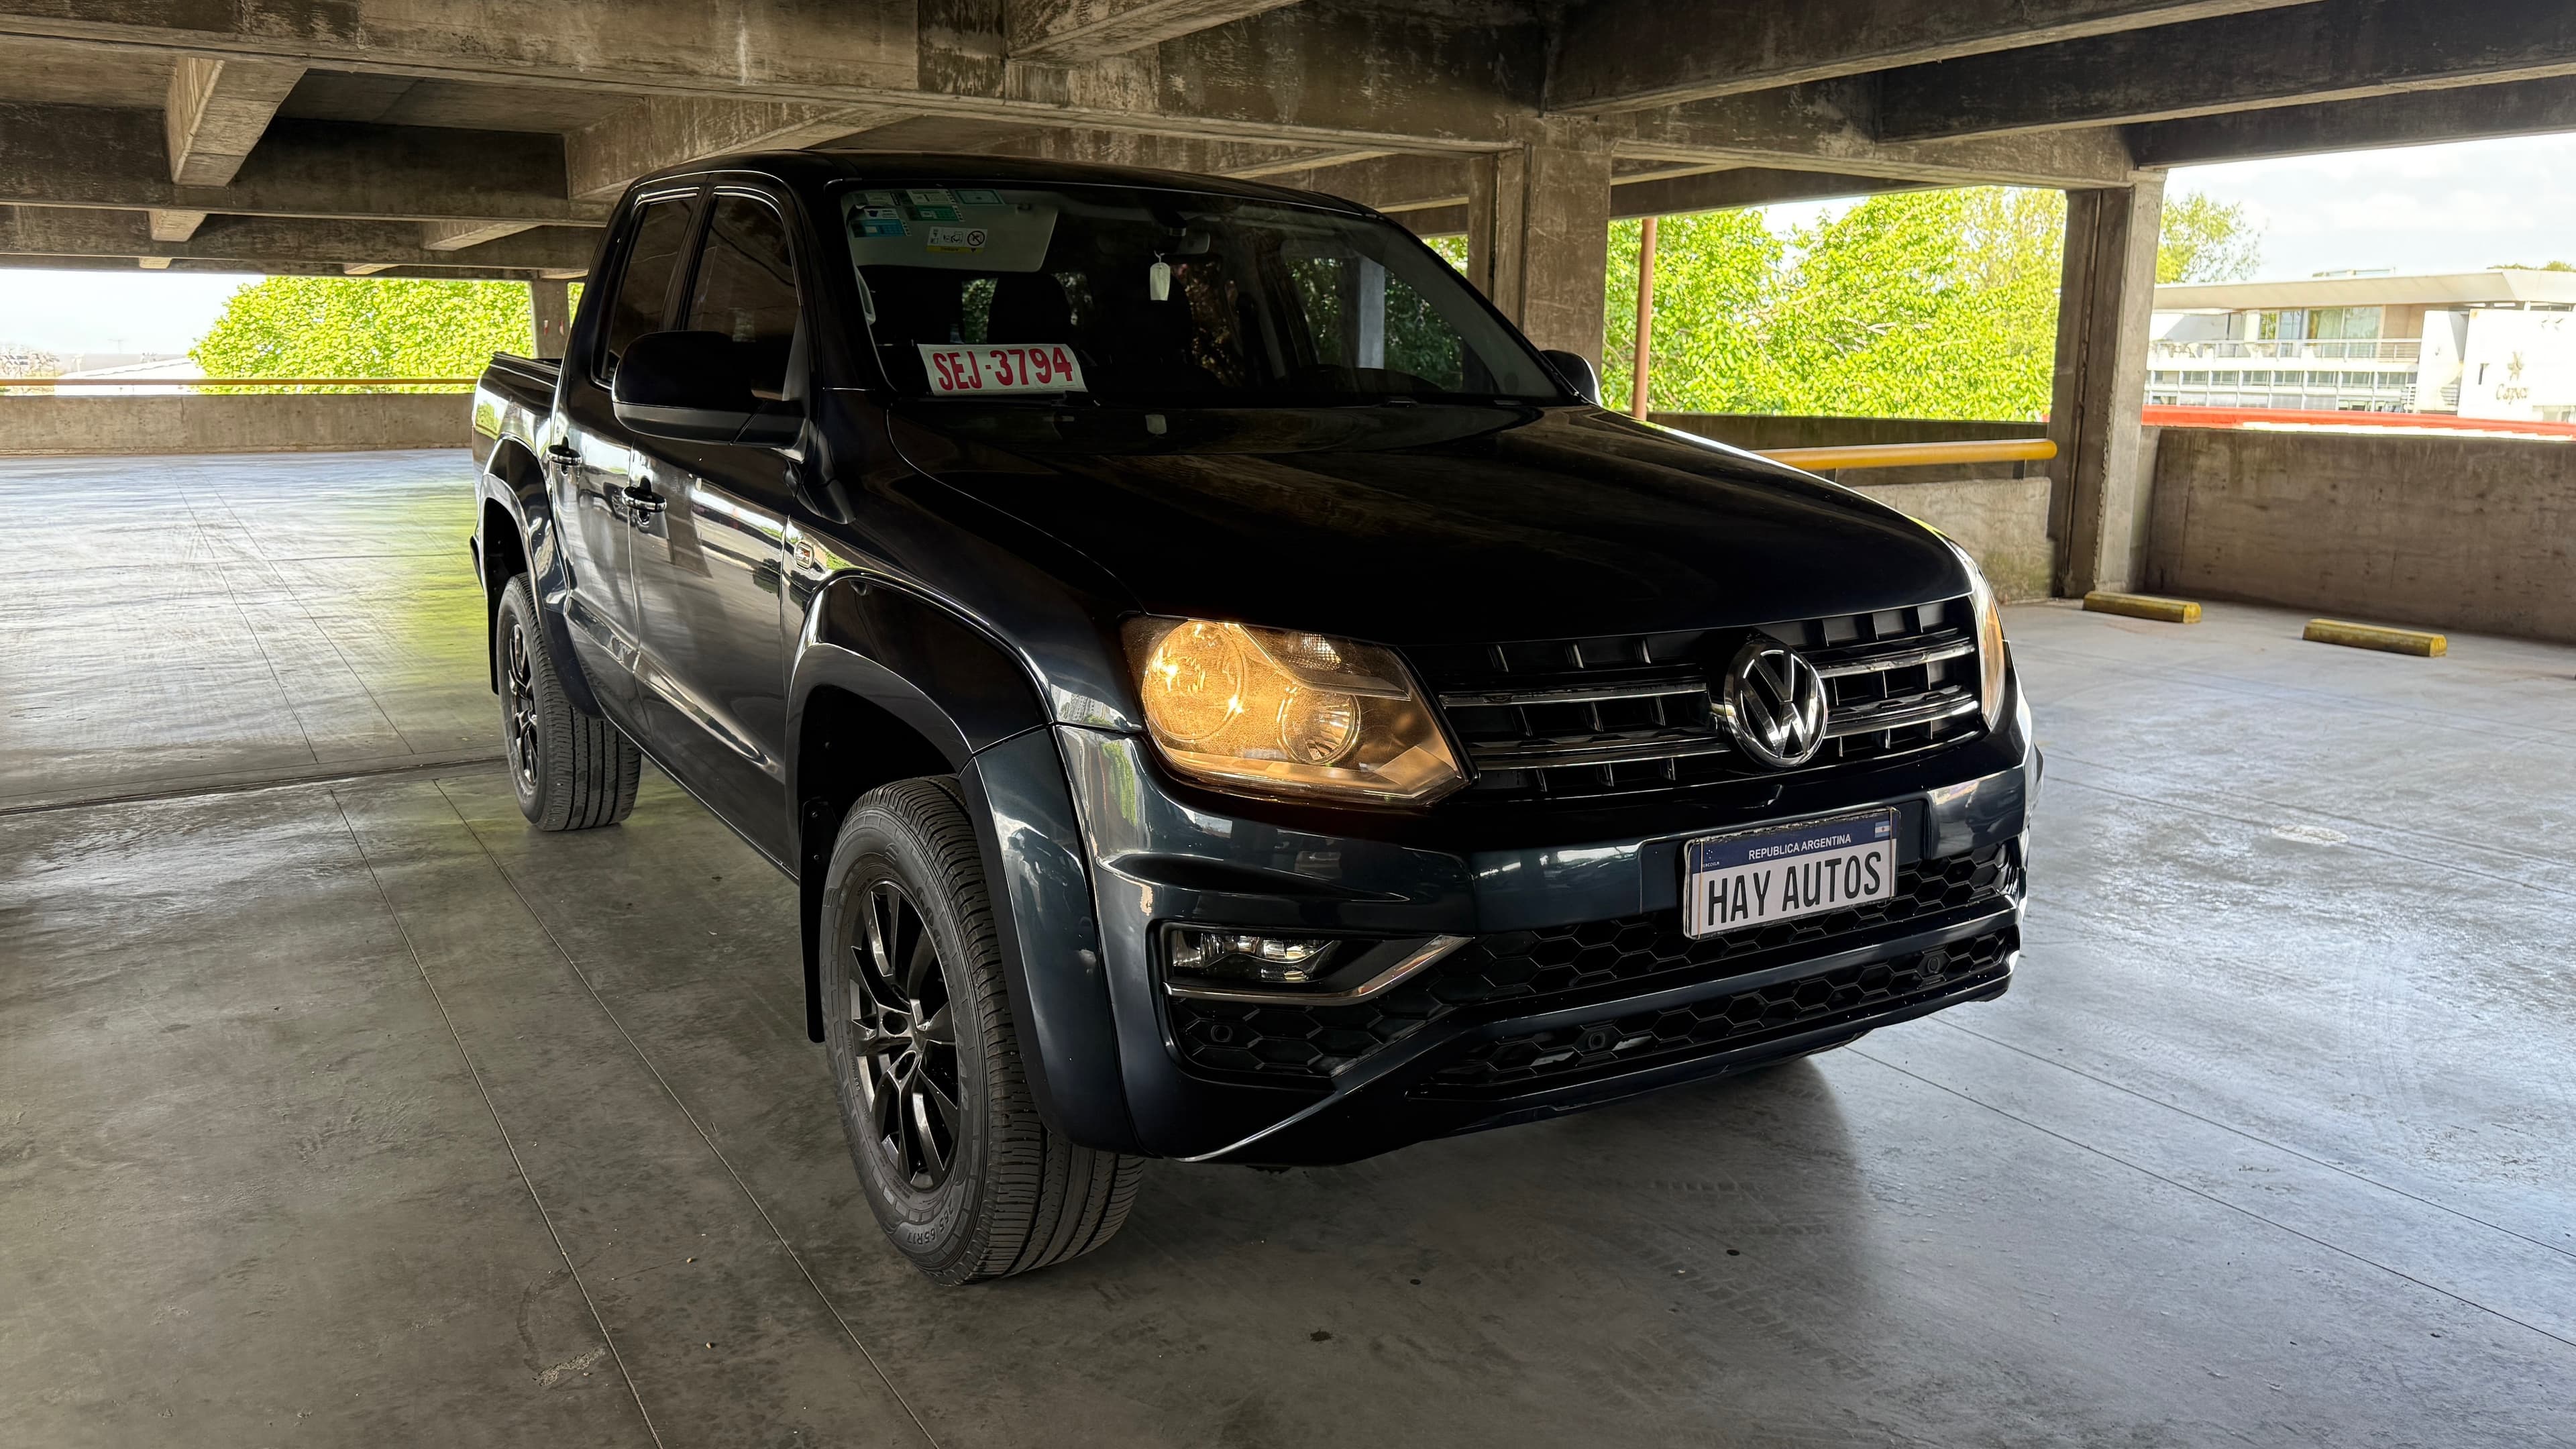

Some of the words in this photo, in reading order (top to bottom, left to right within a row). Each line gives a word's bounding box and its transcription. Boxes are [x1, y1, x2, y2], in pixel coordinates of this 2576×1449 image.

[1748, 843, 1800, 860] REPUBLICA
[1801, 833, 1851, 851] ARGENTINA
[1708, 870, 1771, 926] HAY
[1782, 851, 1881, 912] AUTOS
